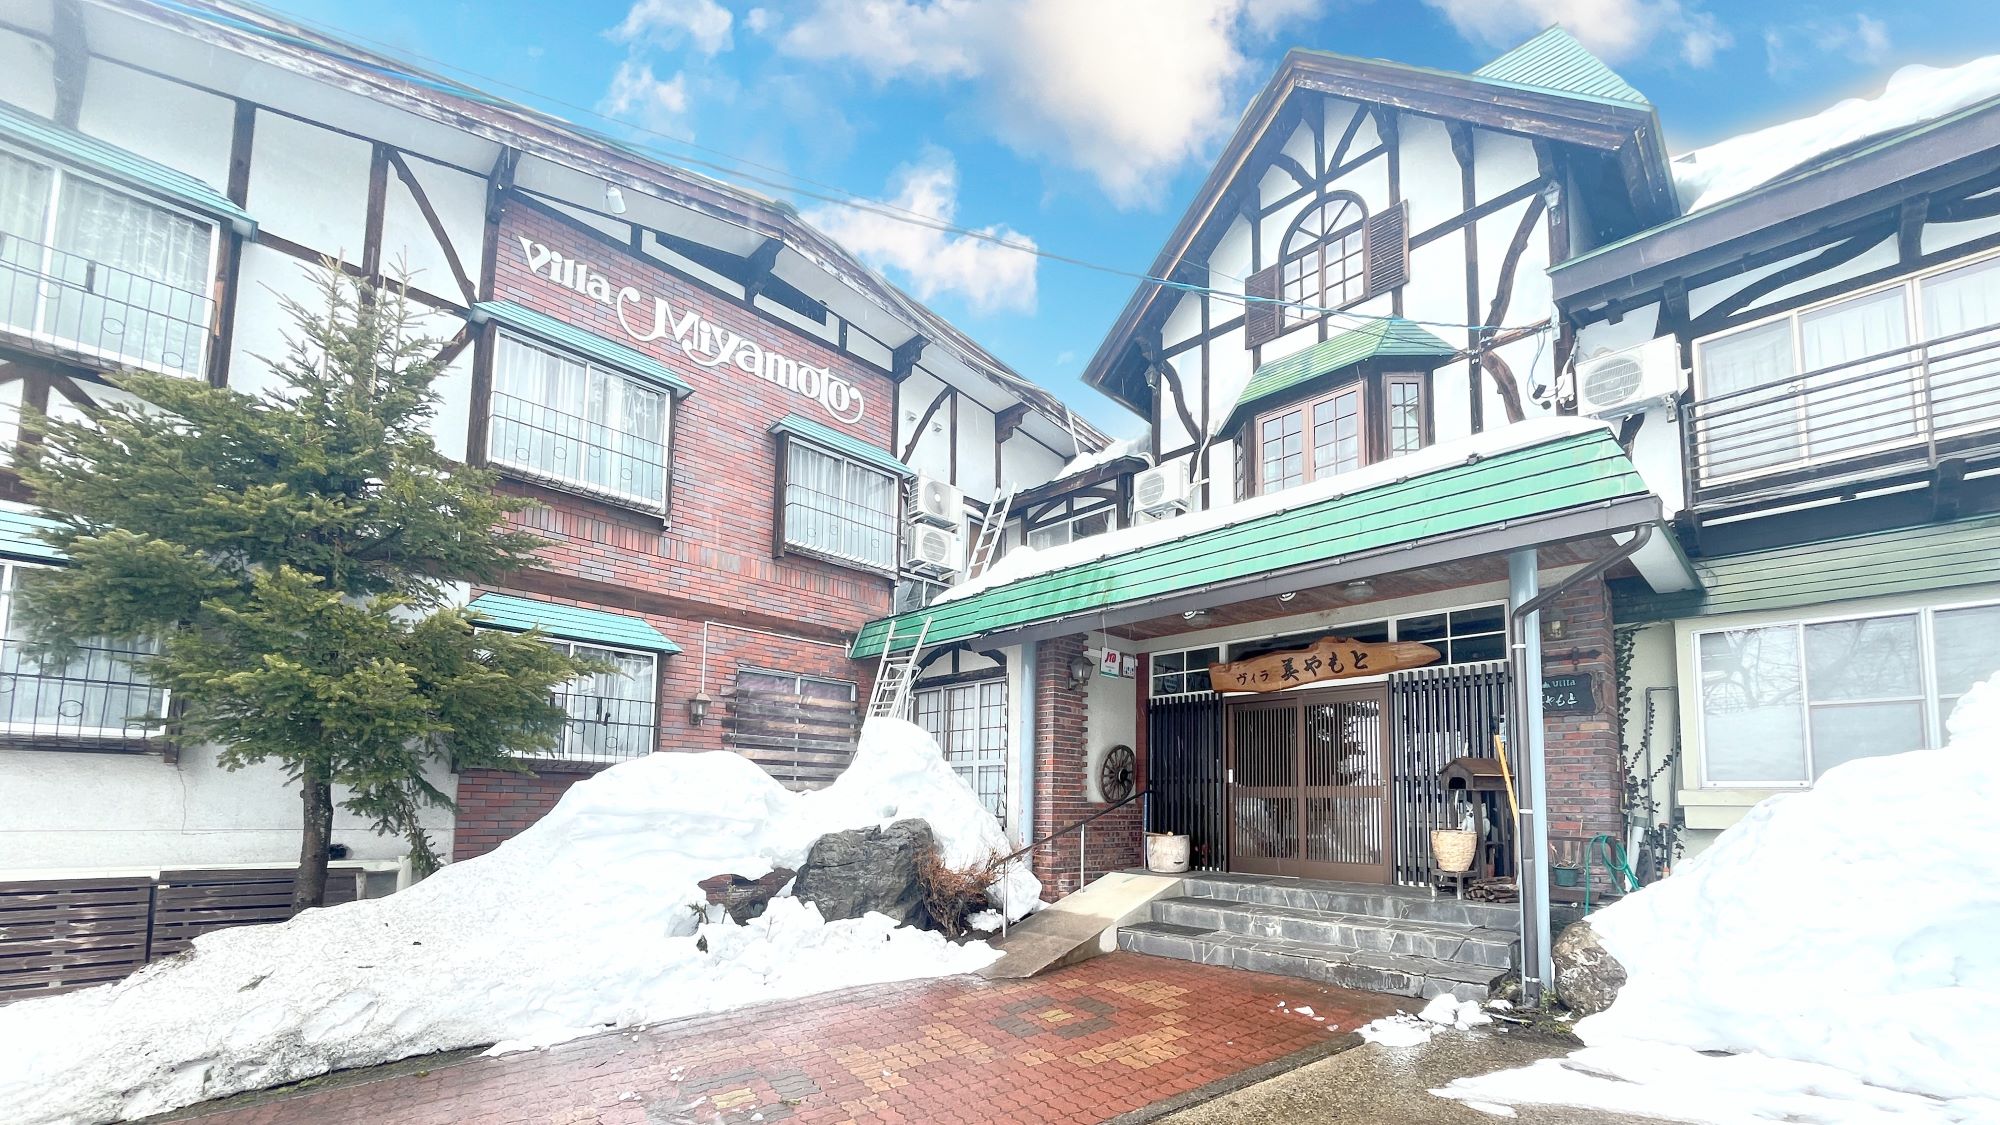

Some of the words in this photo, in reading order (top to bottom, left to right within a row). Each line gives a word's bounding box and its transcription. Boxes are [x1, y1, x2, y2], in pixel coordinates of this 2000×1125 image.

[518, 236, 613, 304] Villa
[617, 286, 864, 424] Miyamoto
[1236, 669, 1269, 686] ヴィラ
[1280, 650, 1369, 682] 美やもと
